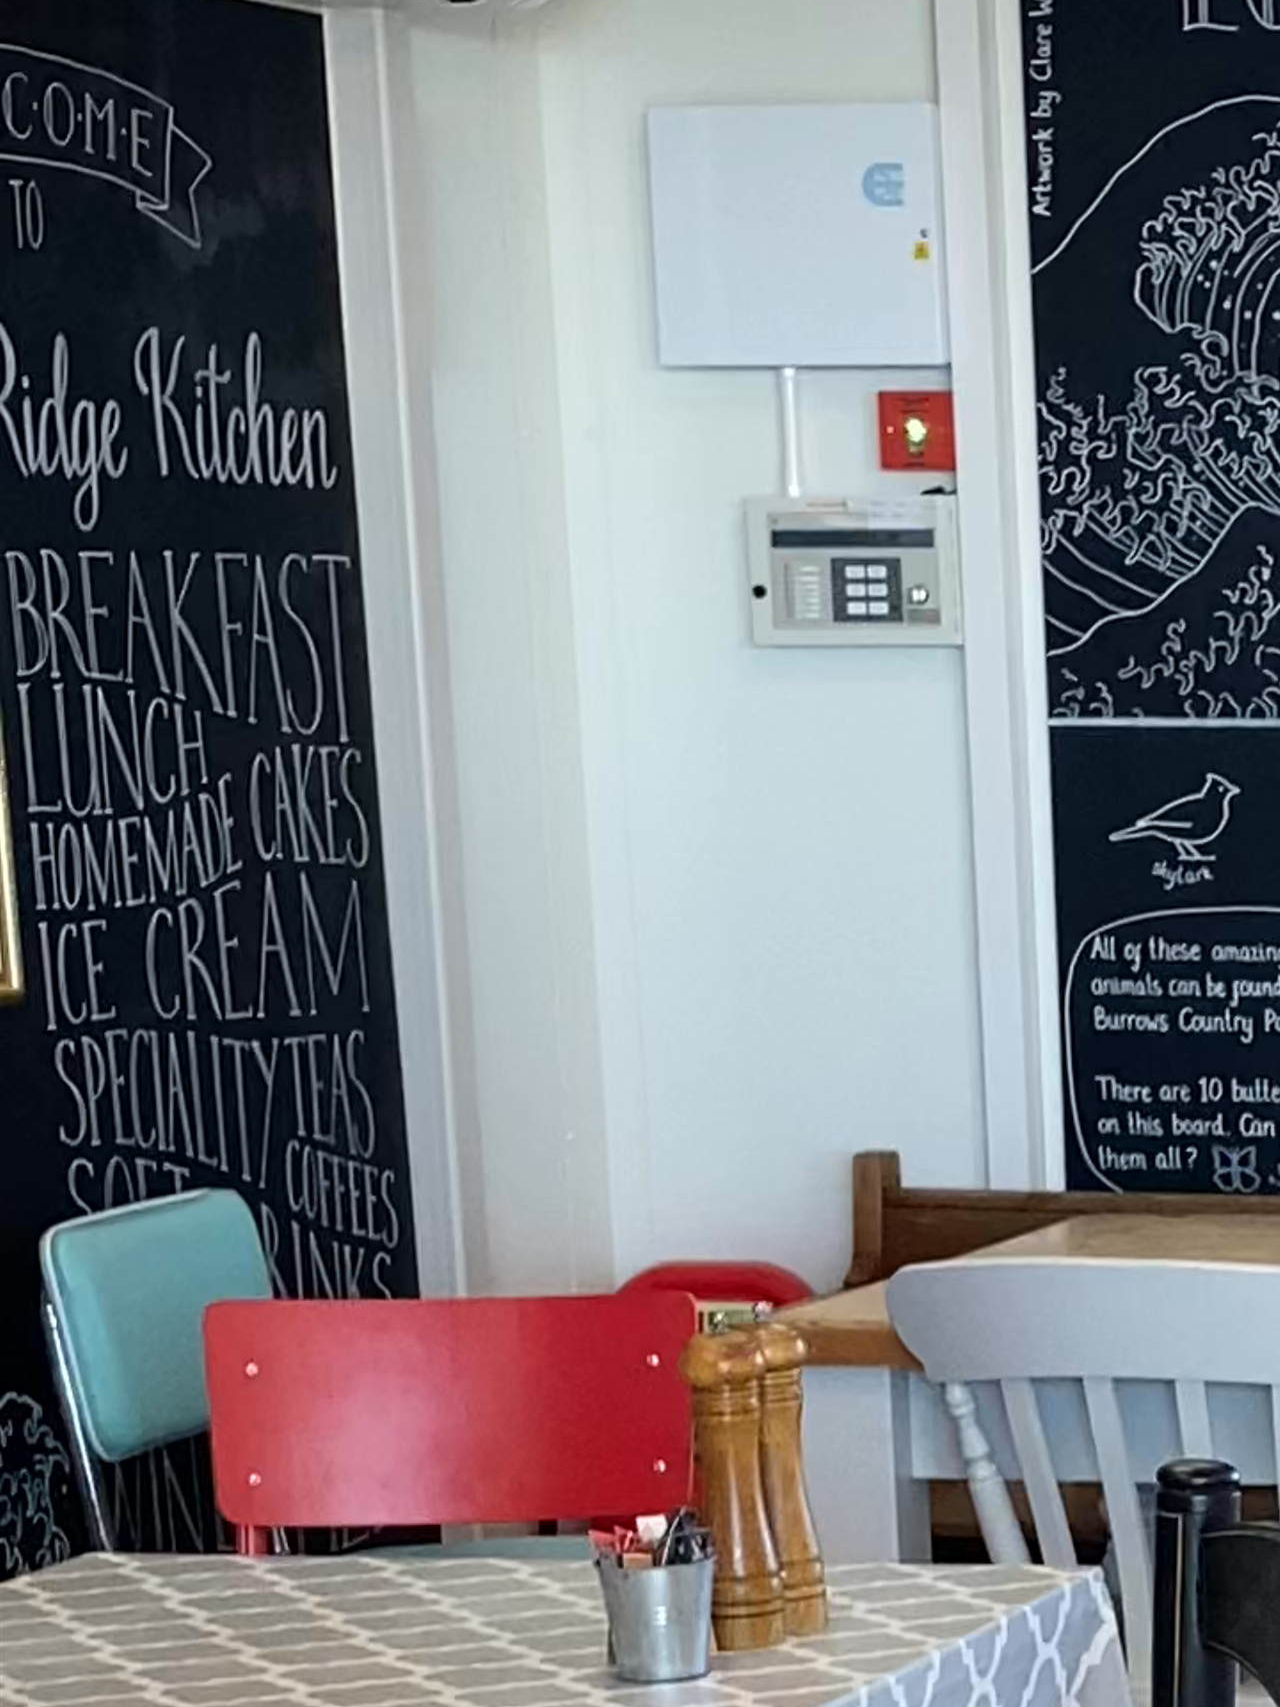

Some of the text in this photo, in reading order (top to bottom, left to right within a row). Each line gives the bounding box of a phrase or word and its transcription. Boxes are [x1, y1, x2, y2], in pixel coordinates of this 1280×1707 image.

[1027, 13, 1054, 84] Clare
[0, 70, 155, 179] COME
[1029, 90, 1063, 119] by
[8, 178, 46, 251] TO
[1030, 126, 1055, 218] Artwork
[133, 325, 337, 489] Kitchen
[4, 548, 352, 744] BREAKFAST
[15, 681, 210, 818] LUNCH
[29, 742, 370, 912] HOMEMADE CAKES
[37, 869, 370, 1032] ICE CREAM
[1089, 936, 1117, 962] All
[1123, 942, 1142, 973] of
[1148, 935, 1202, 962] these
[1090, 972, 1164, 997] animals
[1168, 978, 1202, 998] can
[1205, 972, 1227, 999] be
[1093, 1004, 1170, 1033] Burrows
[1178, 1006, 1254, 1044] Country
[53, 1028, 378, 1190] SPECIALITY TEAS
[1094, 1074, 1153, 1104] There
[1158, 1084, 1191, 1103] are
[1198, 1076, 1224, 1103] 10
[1097, 1117, 1121, 1135] on
[1127, 1110, 1164, 1137] this
[1171, 1112, 1231, 1137] board.
[1238, 1112, 1276, 1138] Can
[284, 1138, 400, 1251] COFFEES
[1097, 1144, 1198, 1171] them all?
[259, 1201, 393, 1301] RINKS
